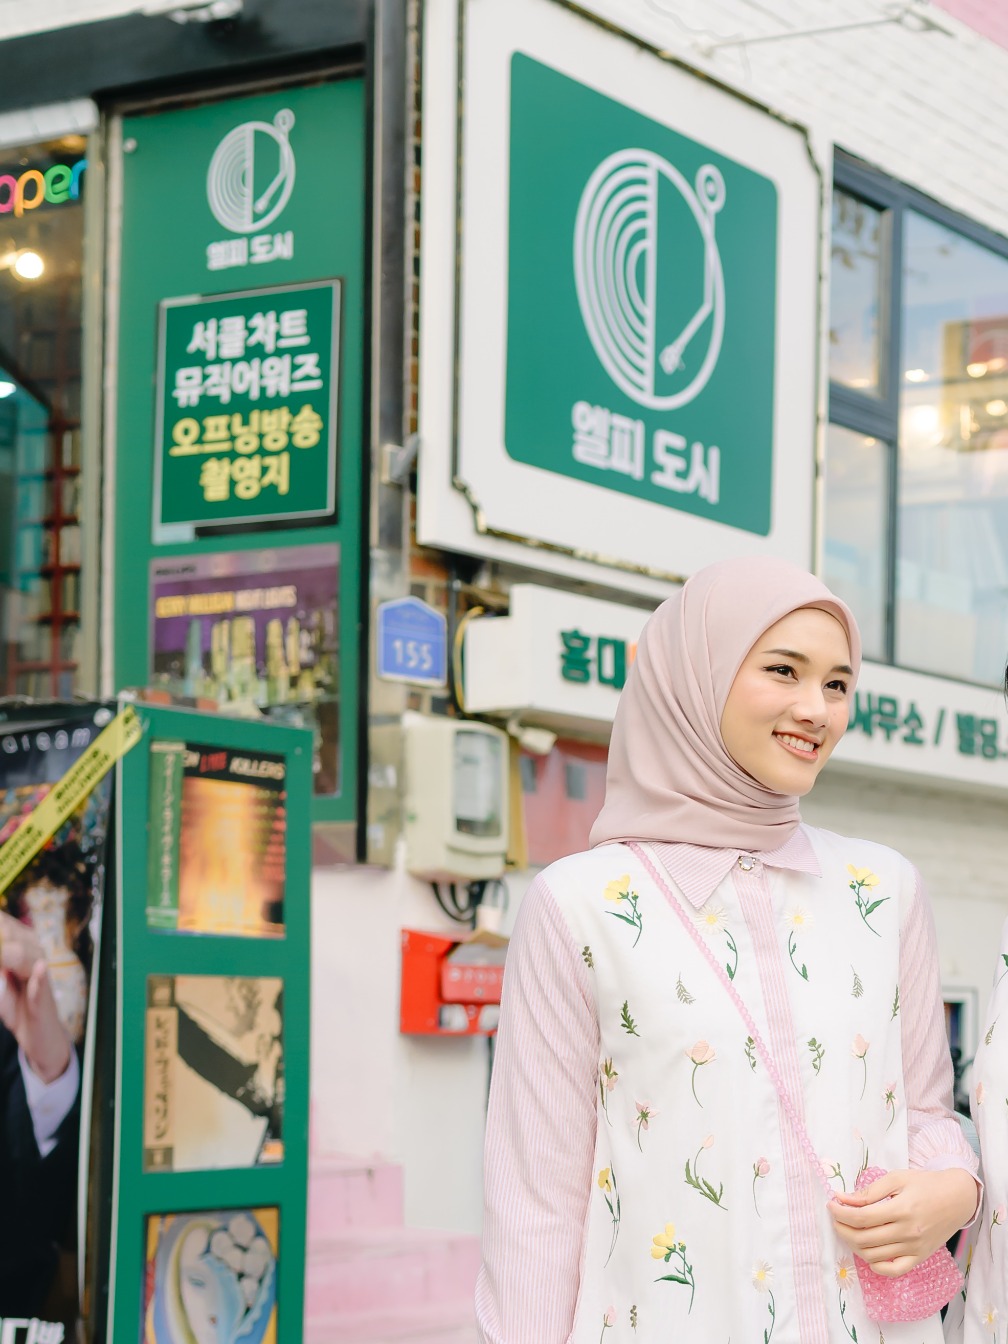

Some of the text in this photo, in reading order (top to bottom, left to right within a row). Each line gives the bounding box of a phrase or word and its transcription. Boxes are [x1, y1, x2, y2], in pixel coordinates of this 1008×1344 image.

[249, 230, 294, 265] 도시
[171, 353, 323, 408] 뮤직어워즈
[168, 404, 323, 457] 오프닝방송
[571, 400, 720, 505] 엘피 도시
[393, 640, 433, 671] 155
[560, 629, 627, 691] 홍대
